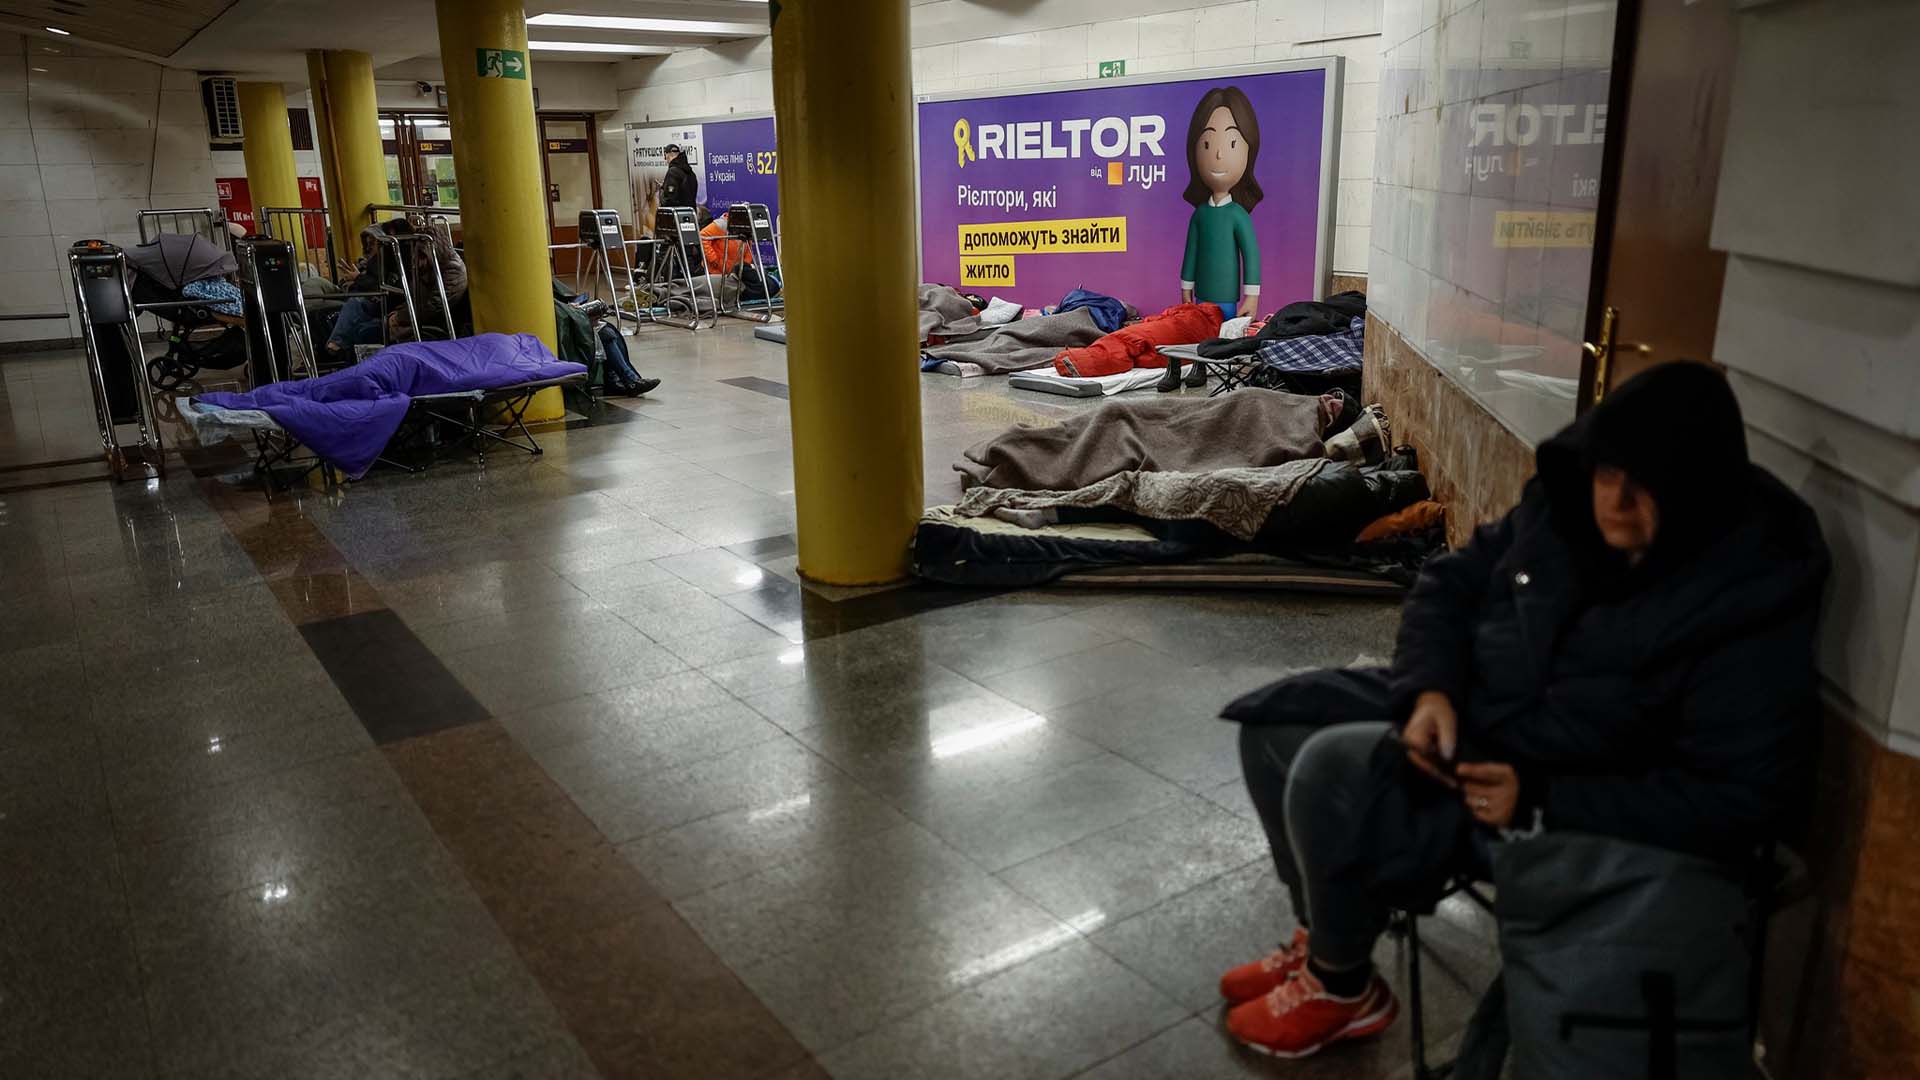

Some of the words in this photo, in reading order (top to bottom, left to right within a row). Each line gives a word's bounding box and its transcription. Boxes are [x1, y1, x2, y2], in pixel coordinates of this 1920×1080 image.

[978, 115, 1166, 160] RIELTOR
[708, 152, 729, 167] Гаряча
[730, 152, 744, 164] лінія
[709, 173, 714, 182] в
[714, 170, 736, 184] Україні
[1090, 166, 1102, 179] від
[1127, 165, 1166, 189] лун
[957, 185, 1029, 213] Рієлтори,
[1032, 185, 1057, 208] які
[964, 226, 1058, 251] допоможуть
[1062, 224, 1119, 245] знайти
[965, 261, 1010, 279] житло
